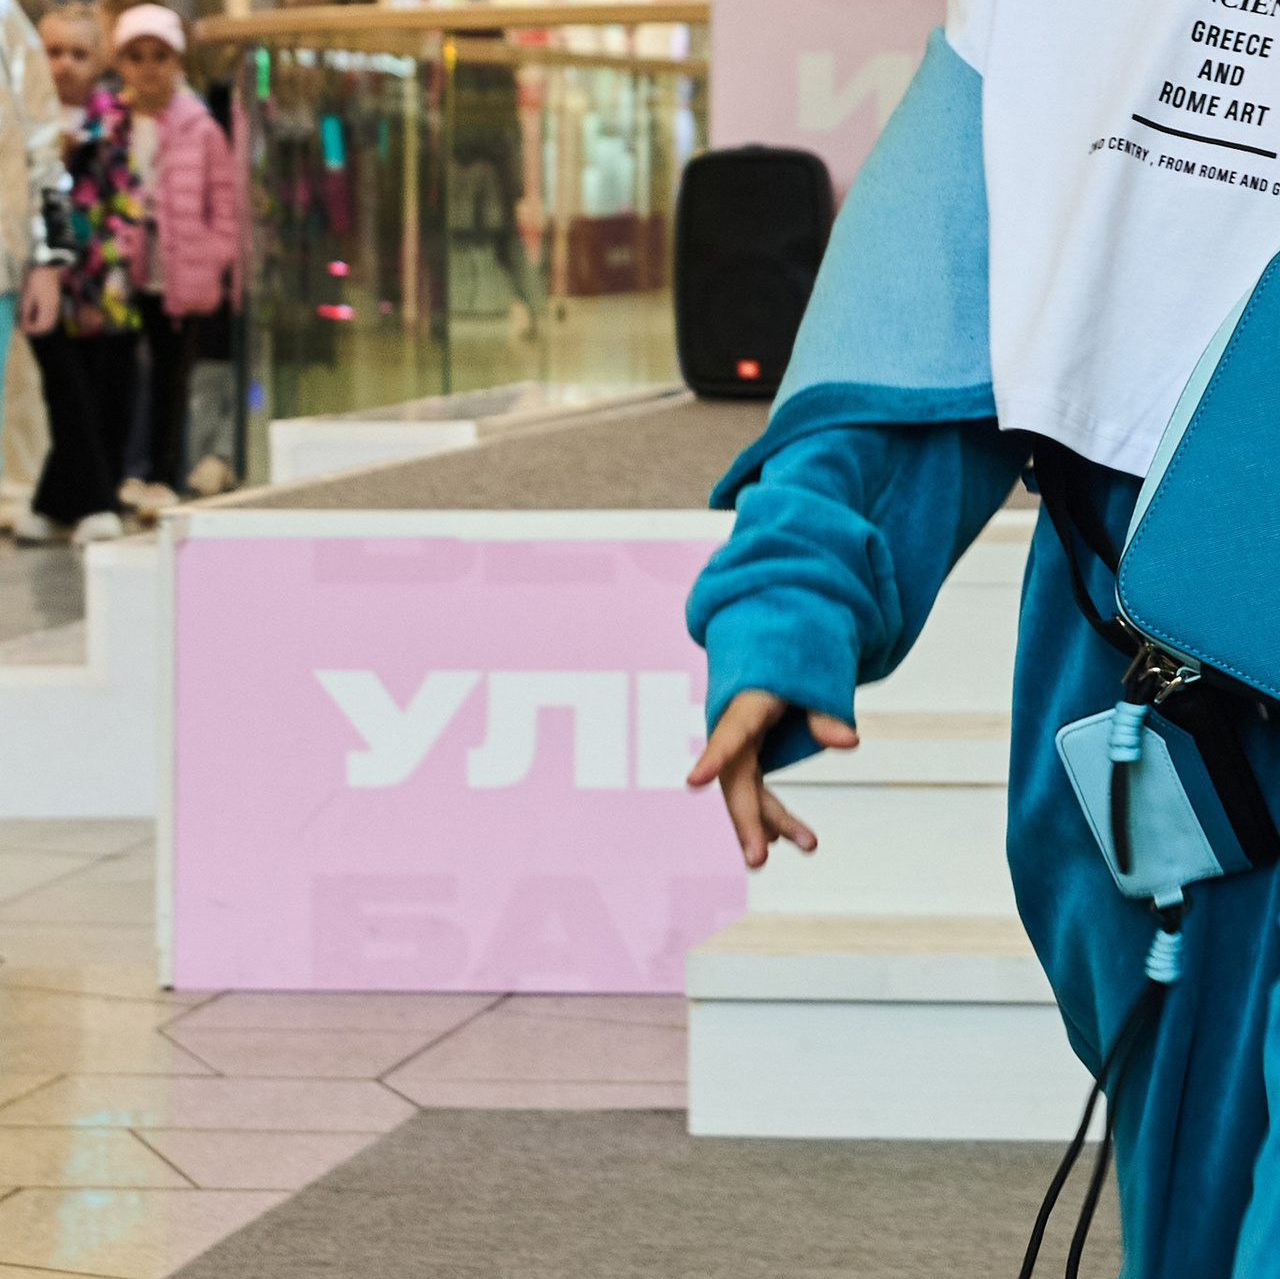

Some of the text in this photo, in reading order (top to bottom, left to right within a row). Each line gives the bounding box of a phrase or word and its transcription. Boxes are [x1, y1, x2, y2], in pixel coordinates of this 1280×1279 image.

[1190, 20, 1274, 59] GREECE
[1197, 58, 1246, 87] AND
[1158, 80, 1271, 127] ROME ART
[1158, 154, 1196, 176] FROM
[1198, 164, 1238, 186] ROME
[1239, 173, 1268, 193] AND
